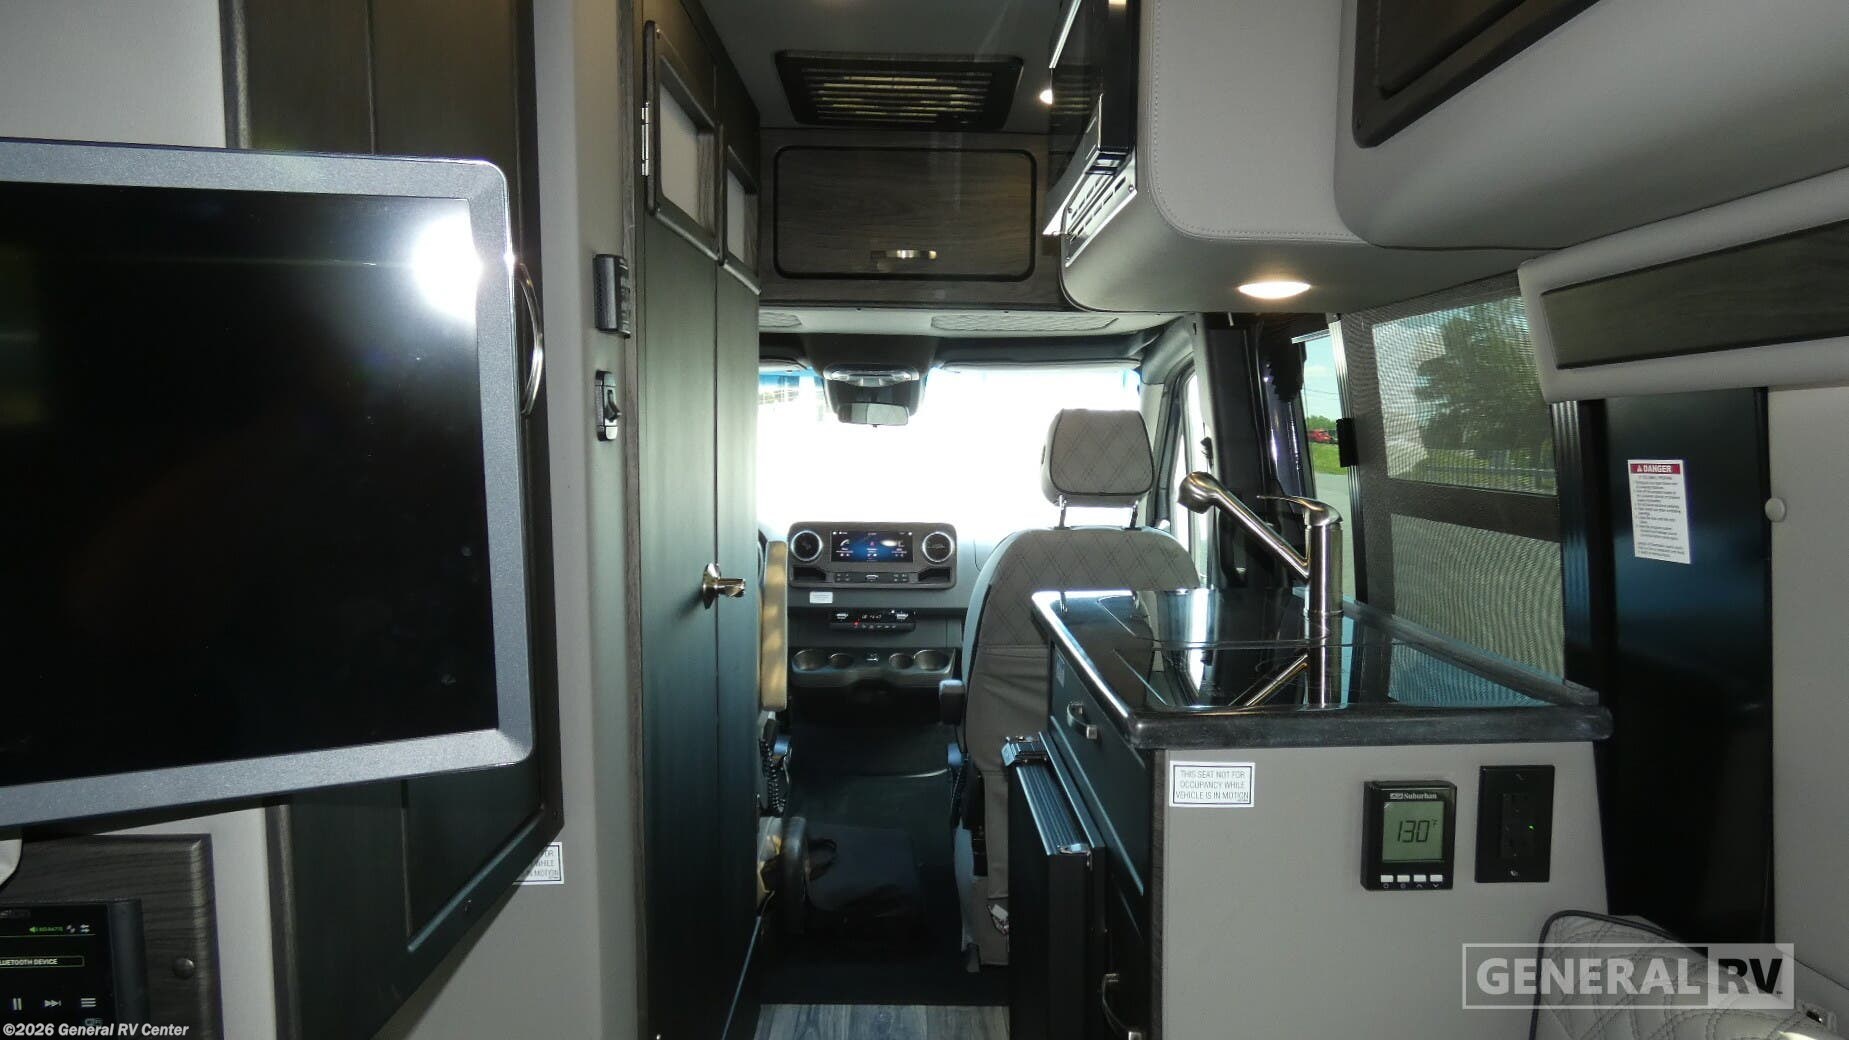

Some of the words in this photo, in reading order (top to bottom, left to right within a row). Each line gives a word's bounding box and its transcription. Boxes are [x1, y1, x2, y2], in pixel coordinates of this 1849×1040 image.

[1643, 464, 1672, 473] DANGER
[1180, 770, 1196, 778] THIS
[1198, 770, 1214, 779] SEAT
[1216, 770, 1230, 779] NOT
[1232, 770, 1246, 779] FOR
[1180, 781, 1222, 789] OCCUPANCY
[1224, 781, 1245, 789] WHILE
[1175, 791, 1204, 800] VEHICLE
[1205, 791, 1212, 800] IS
[1213, 791, 1221, 800] IN
[1222, 791, 1249, 800] MOTION
[1404, 792, 1437, 800] Suburban
